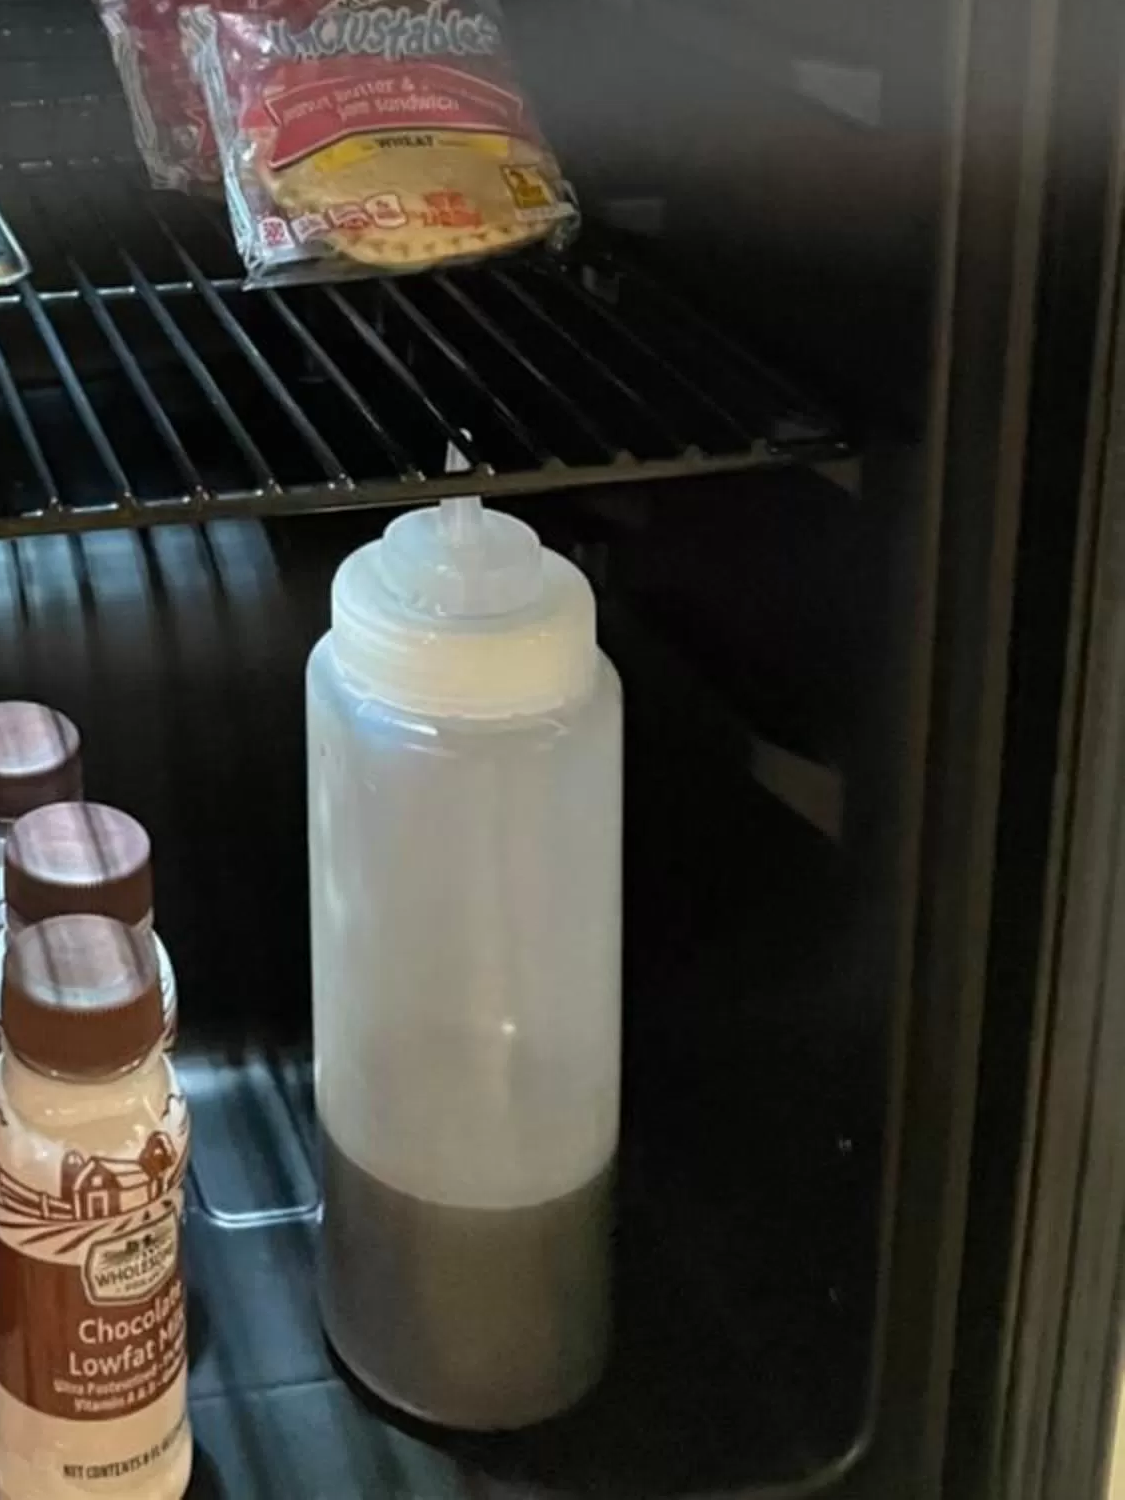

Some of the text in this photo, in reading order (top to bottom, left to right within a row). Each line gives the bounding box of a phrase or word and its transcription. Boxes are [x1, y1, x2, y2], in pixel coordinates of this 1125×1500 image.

[375, 134, 435, 148] WHEAT
[69, 1342, 155, 1378] Lowfat
[63, 1463, 84, 1479] NET
[86, 1456, 142, 1480] CONTENTS
